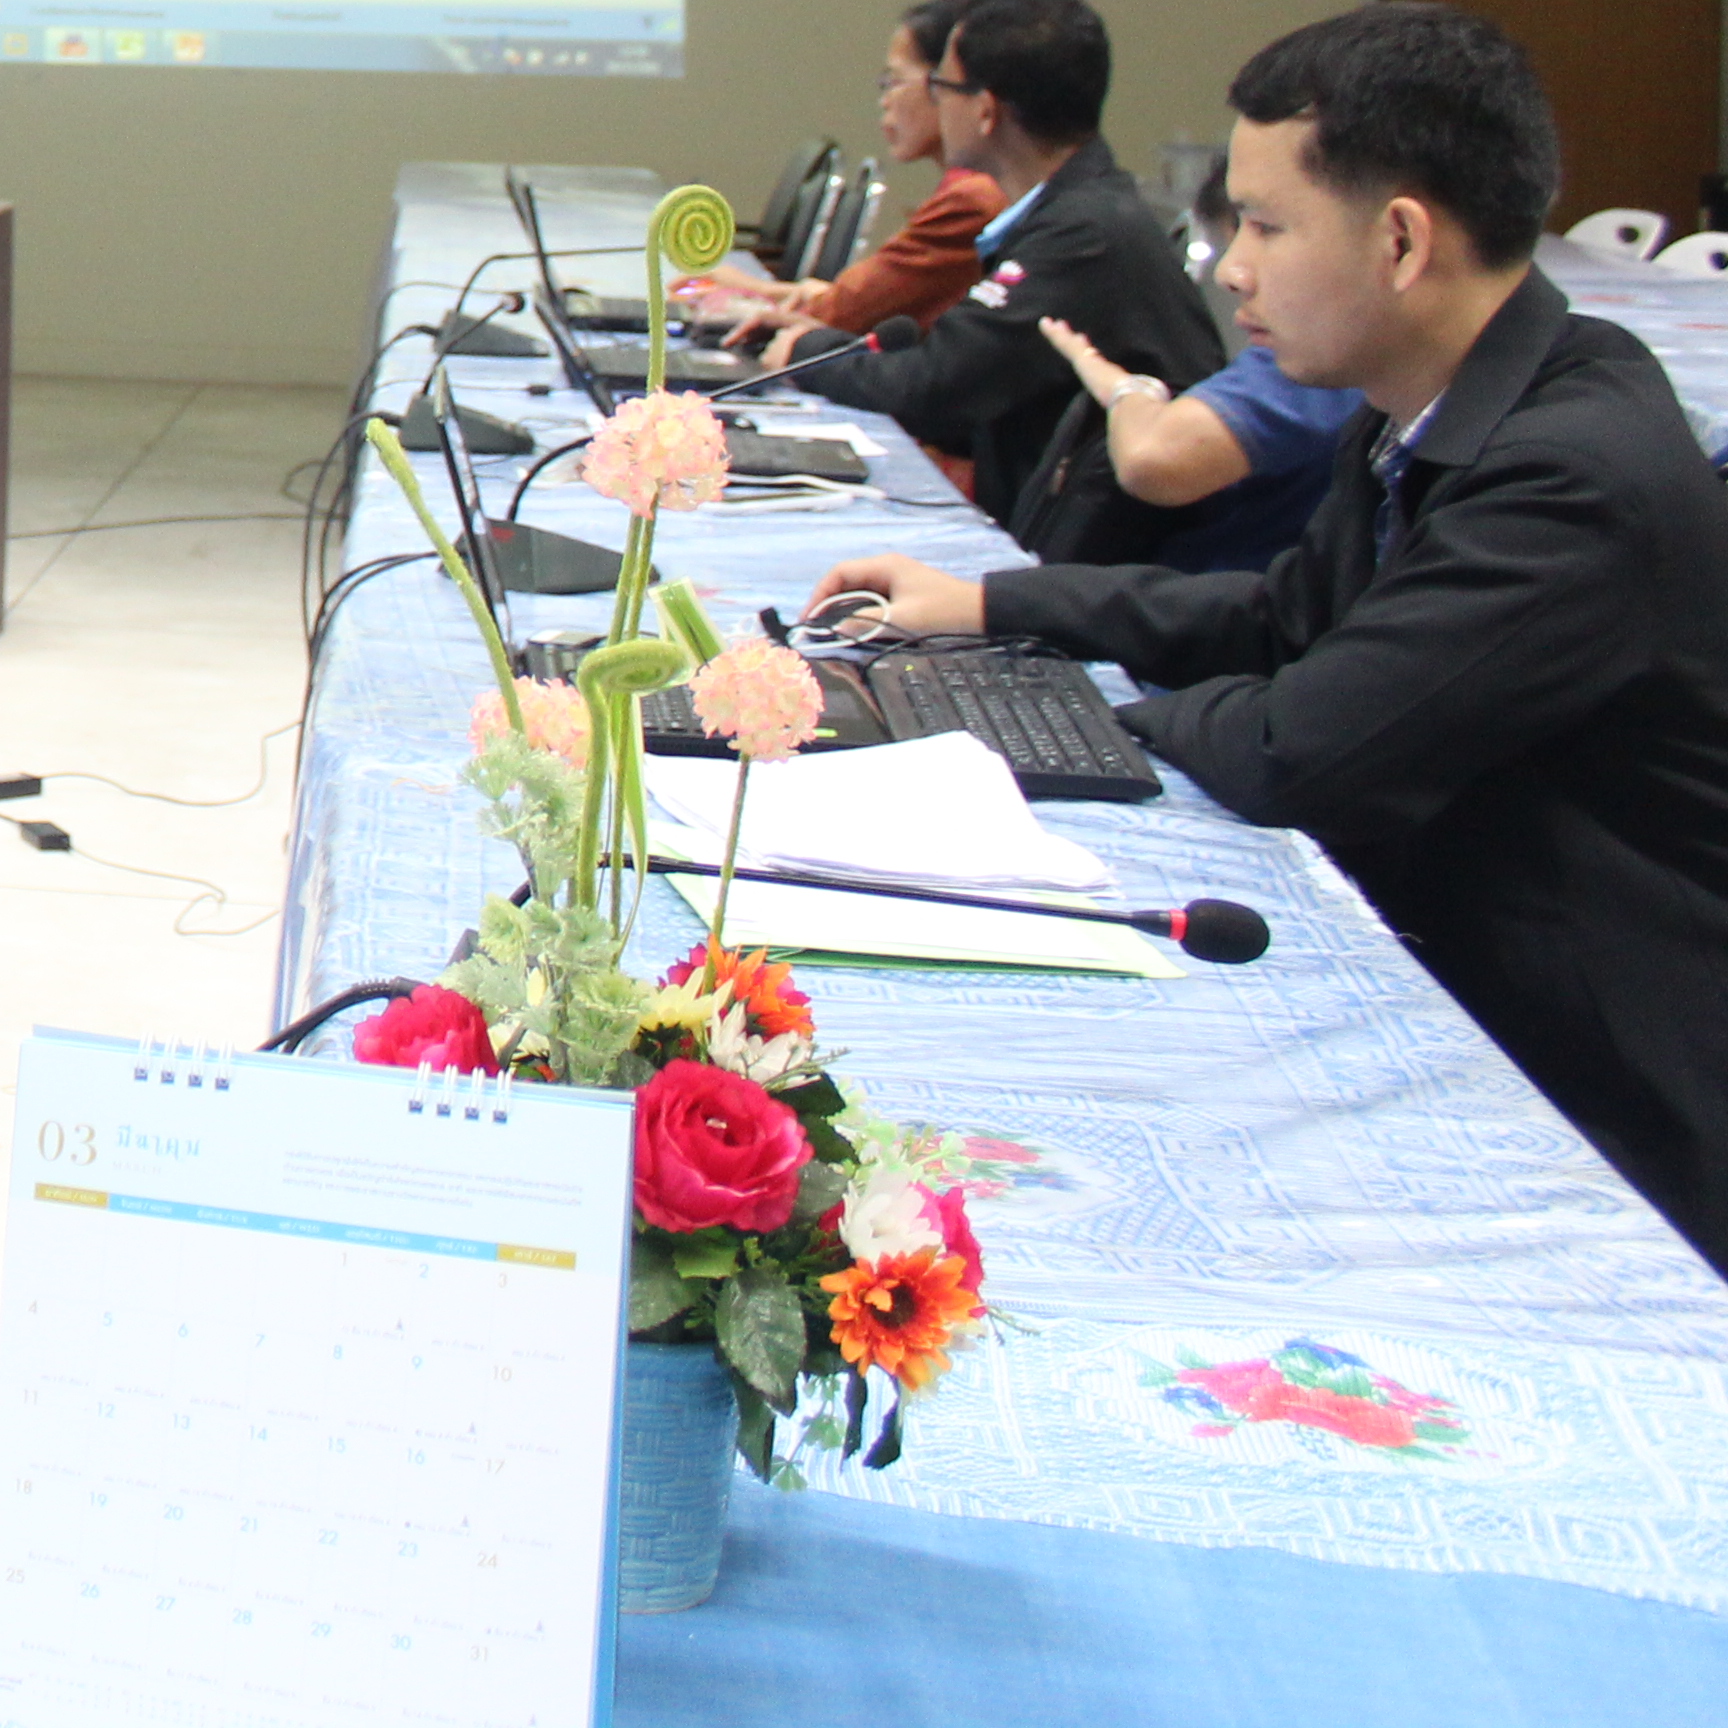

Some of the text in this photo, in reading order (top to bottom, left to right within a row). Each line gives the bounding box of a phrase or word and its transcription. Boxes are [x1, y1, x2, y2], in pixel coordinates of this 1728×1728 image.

[38, 1119, 98, 1167] 03
[419, 1263, 429, 1279] 2
[29, 1300, 512, 1383] 4 5 6 7 8 9 10
[98, 1402, 115, 1418] 12
[173, 1413, 191, 1430] 13
[251, 1425, 267, 1441] 14
[328, 1436, 346, 1454] 15
[408, 1448, 425, 1465] 16
[17, 1478, 497, 1568] 18 19 20 21 22 23 24
[6, 1567, 488, 1662] 25 26 27 28 29 30 31
